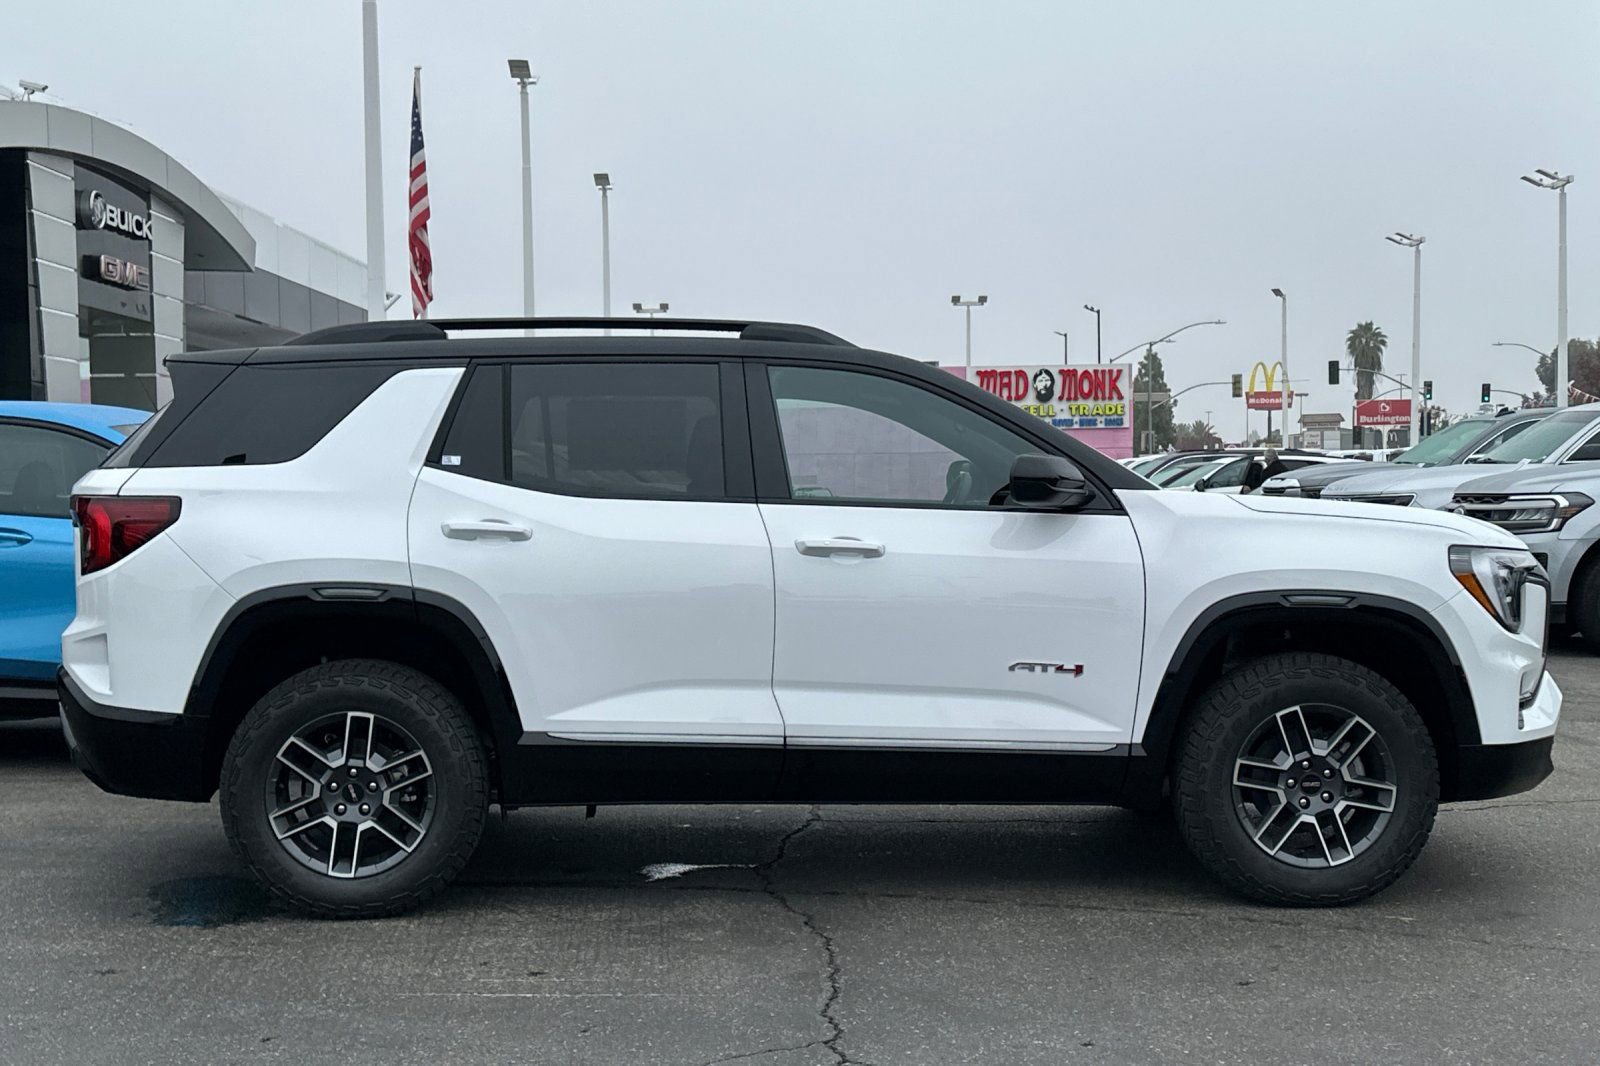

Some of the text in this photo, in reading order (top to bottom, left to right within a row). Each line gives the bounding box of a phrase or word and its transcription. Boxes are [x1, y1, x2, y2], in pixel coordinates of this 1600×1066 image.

[106, 204, 153, 240] BUICK
[101, 255, 150, 292] GMC
[976, 369, 1124, 401] MAD MONK
[1069, 403, 1126, 417] TRADE
[1360, 414, 1411, 424] Burlington
[1008, 662, 1085, 678] AT4
